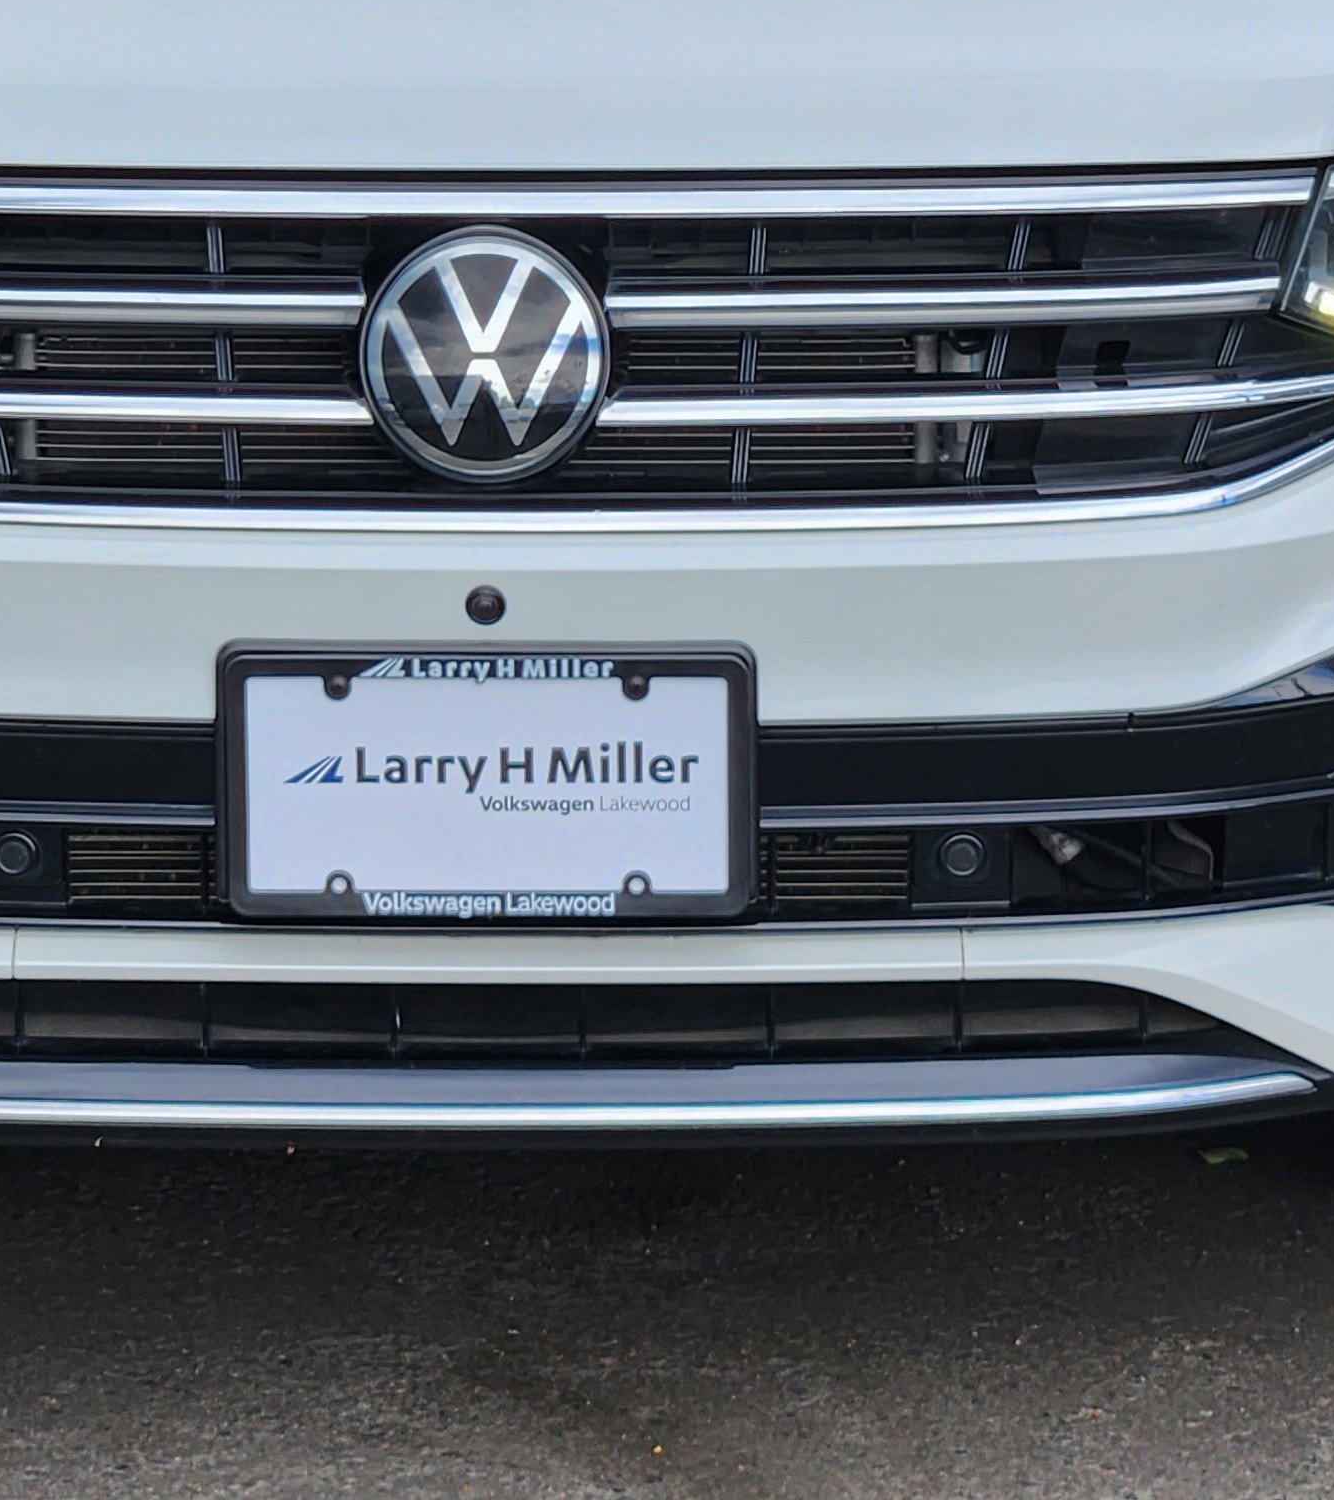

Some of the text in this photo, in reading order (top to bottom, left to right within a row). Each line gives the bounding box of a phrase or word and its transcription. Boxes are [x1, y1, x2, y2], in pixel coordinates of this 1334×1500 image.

[366, 235, 603, 472] VW
[411, 657, 614, 683] Larry H Miller
[356, 741, 699, 794] Larry H Miller
[479, 796, 691, 815] Volkswagen Lakewood
[363, 891, 615, 918] Volkswagen Lakewood
